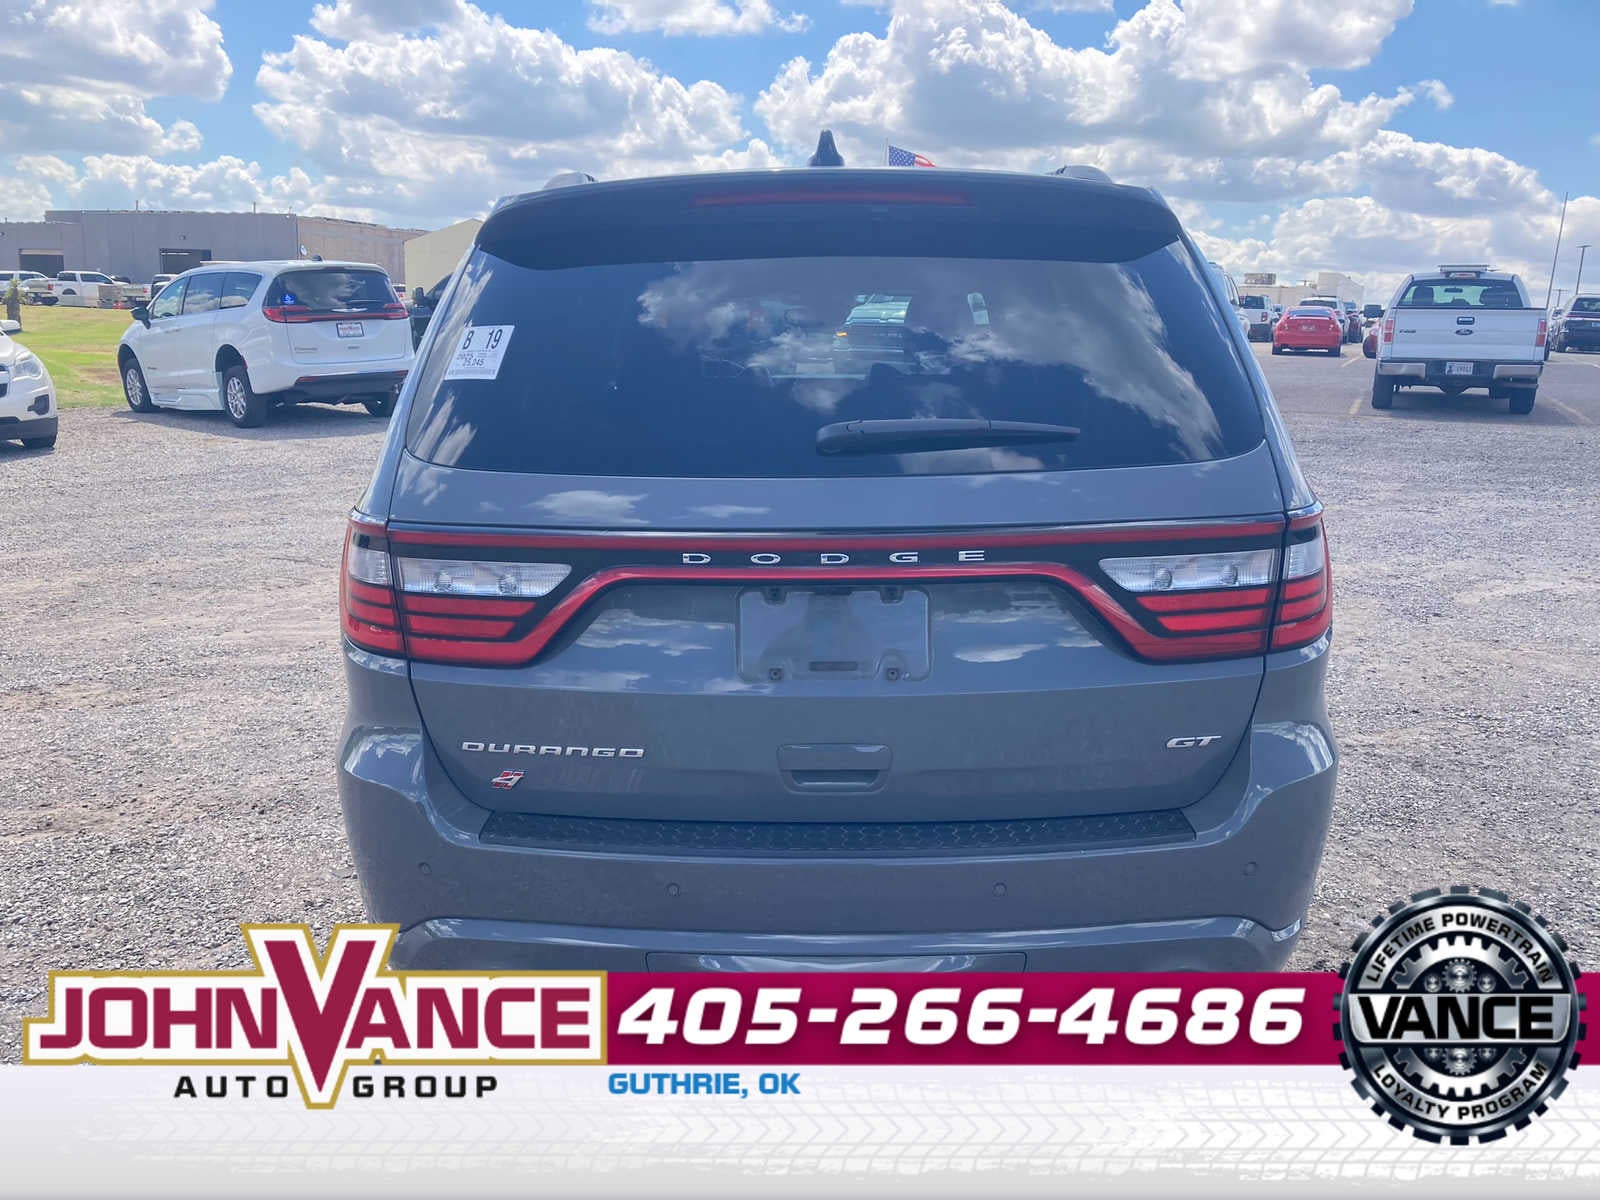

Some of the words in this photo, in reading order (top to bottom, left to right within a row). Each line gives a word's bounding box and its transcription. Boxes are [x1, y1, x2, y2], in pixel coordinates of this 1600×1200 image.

[486, 328, 503, 349] 19
[682, 550, 986, 564] DODGE
[1166, 735, 1222, 748] GT
[461, 741, 645, 758] DURANGO
